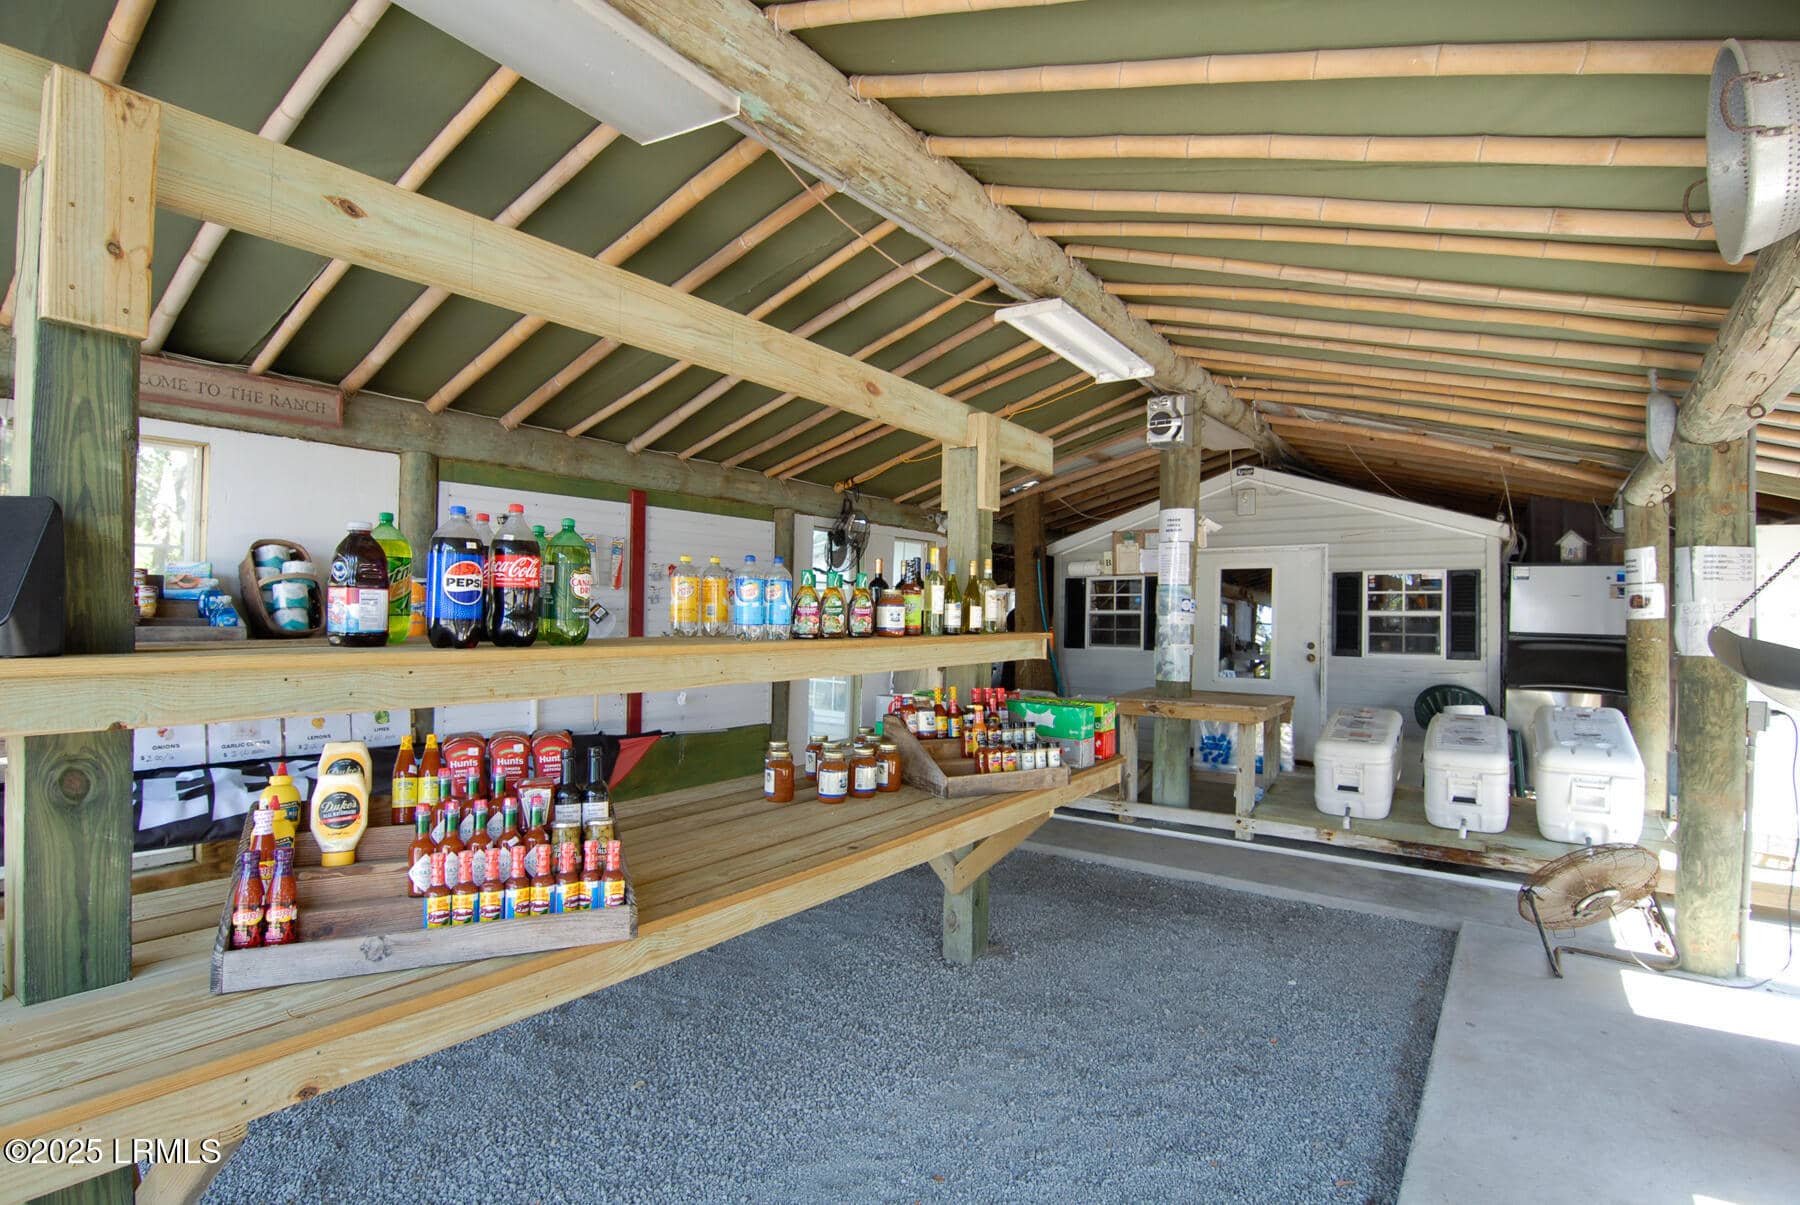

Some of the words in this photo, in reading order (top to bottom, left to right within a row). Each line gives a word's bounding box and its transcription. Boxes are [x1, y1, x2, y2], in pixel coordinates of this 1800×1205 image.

[197, 381, 221, 398] TO
[230, 386, 263, 404] THE
[270, 393, 327, 414] RANCH
[307, 733, 331, 741] LEMONS
[152, 743, 180, 751] ONIONS
[221, 741, 245, 750] GARLIC
[320, 799, 357, 813] Duke's
